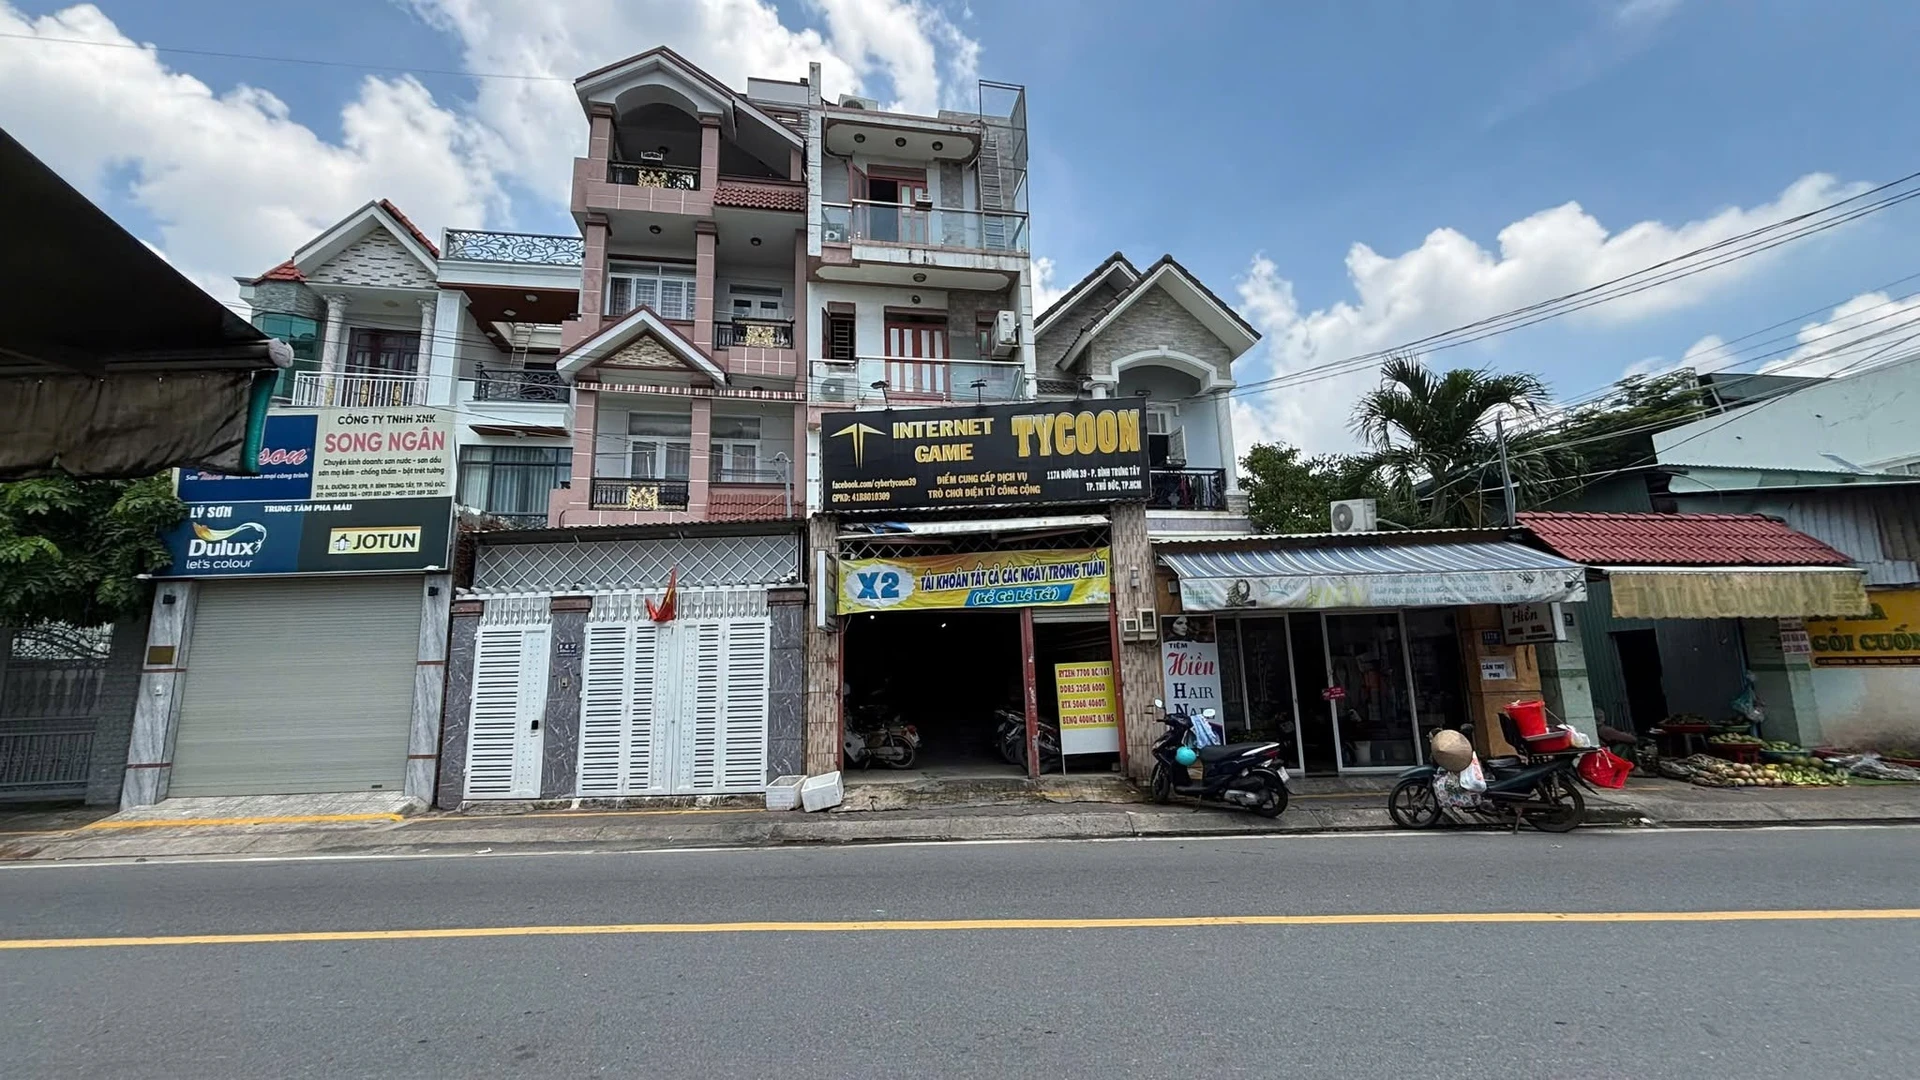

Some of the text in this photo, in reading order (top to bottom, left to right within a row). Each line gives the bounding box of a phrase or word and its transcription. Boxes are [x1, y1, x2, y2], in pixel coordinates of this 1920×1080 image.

[337, 413, 436, 425] CÔNG TY TNHH XNK
[892, 417, 995, 440] INTERNET
[1010, 408, 1142, 459] TYCOON
[324, 426, 445, 453] SONG NGÂN
[259, 447, 308, 465] son
[322, 458, 347, 468] Chuyên
[347, 458, 361, 466] kinh
[396, 457, 412, 465] nước
[429, 455, 442, 465] dầu
[914, 443, 974, 464] GAME
[293, 471, 309, 479] trình
[330, 470, 341, 478] mạ
[360, 467, 380, 477] chống
[380, 467, 397, 475] thấm
[402, 467, 413, 477] bột
[426, 466, 445, 476] tường
[936, 470, 1029, 485] ĐIỂM CUNG CẤP DỊCH VỤ
[1129, 464, 1141, 477] TÂY
[927, 483, 1042, 499] TRÒ CHƠI ĐIỆN TỬ CÔNG CỘNG
[206, 505, 233, 518] SƠN
[264, 504, 292, 513] TRUNG
[293, 503, 312, 513] TÂM
[313, 503, 332, 512] PHA
[188, 539, 254, 557] Dulux
[352, 532, 417, 550] JOTUN
[186, 558, 253, 570] let's colour
[920, 552, 1106, 591] TÀI KHOẢN TẤT CẢ CÁC NGÀY TRONG TUẦN
[856, 571, 900, 600] X2
[1033, 586, 1060, 602] Tết)
[1512, 605, 1538, 624] Hiền
[1168, 642, 1188, 650] TIỆM
[1811, 626, 1856, 652] GỎI
[1166, 651, 1216, 676] Hiền
[1058, 669, 1076, 678] RYZEN
[1060, 684, 1075, 693] DDR5
[1092, 683, 1106, 691] 6000
[1172, 682, 1215, 699] HAIR
[1061, 700, 1071, 709] RTX
[1062, 716, 1077, 725] BENQ
